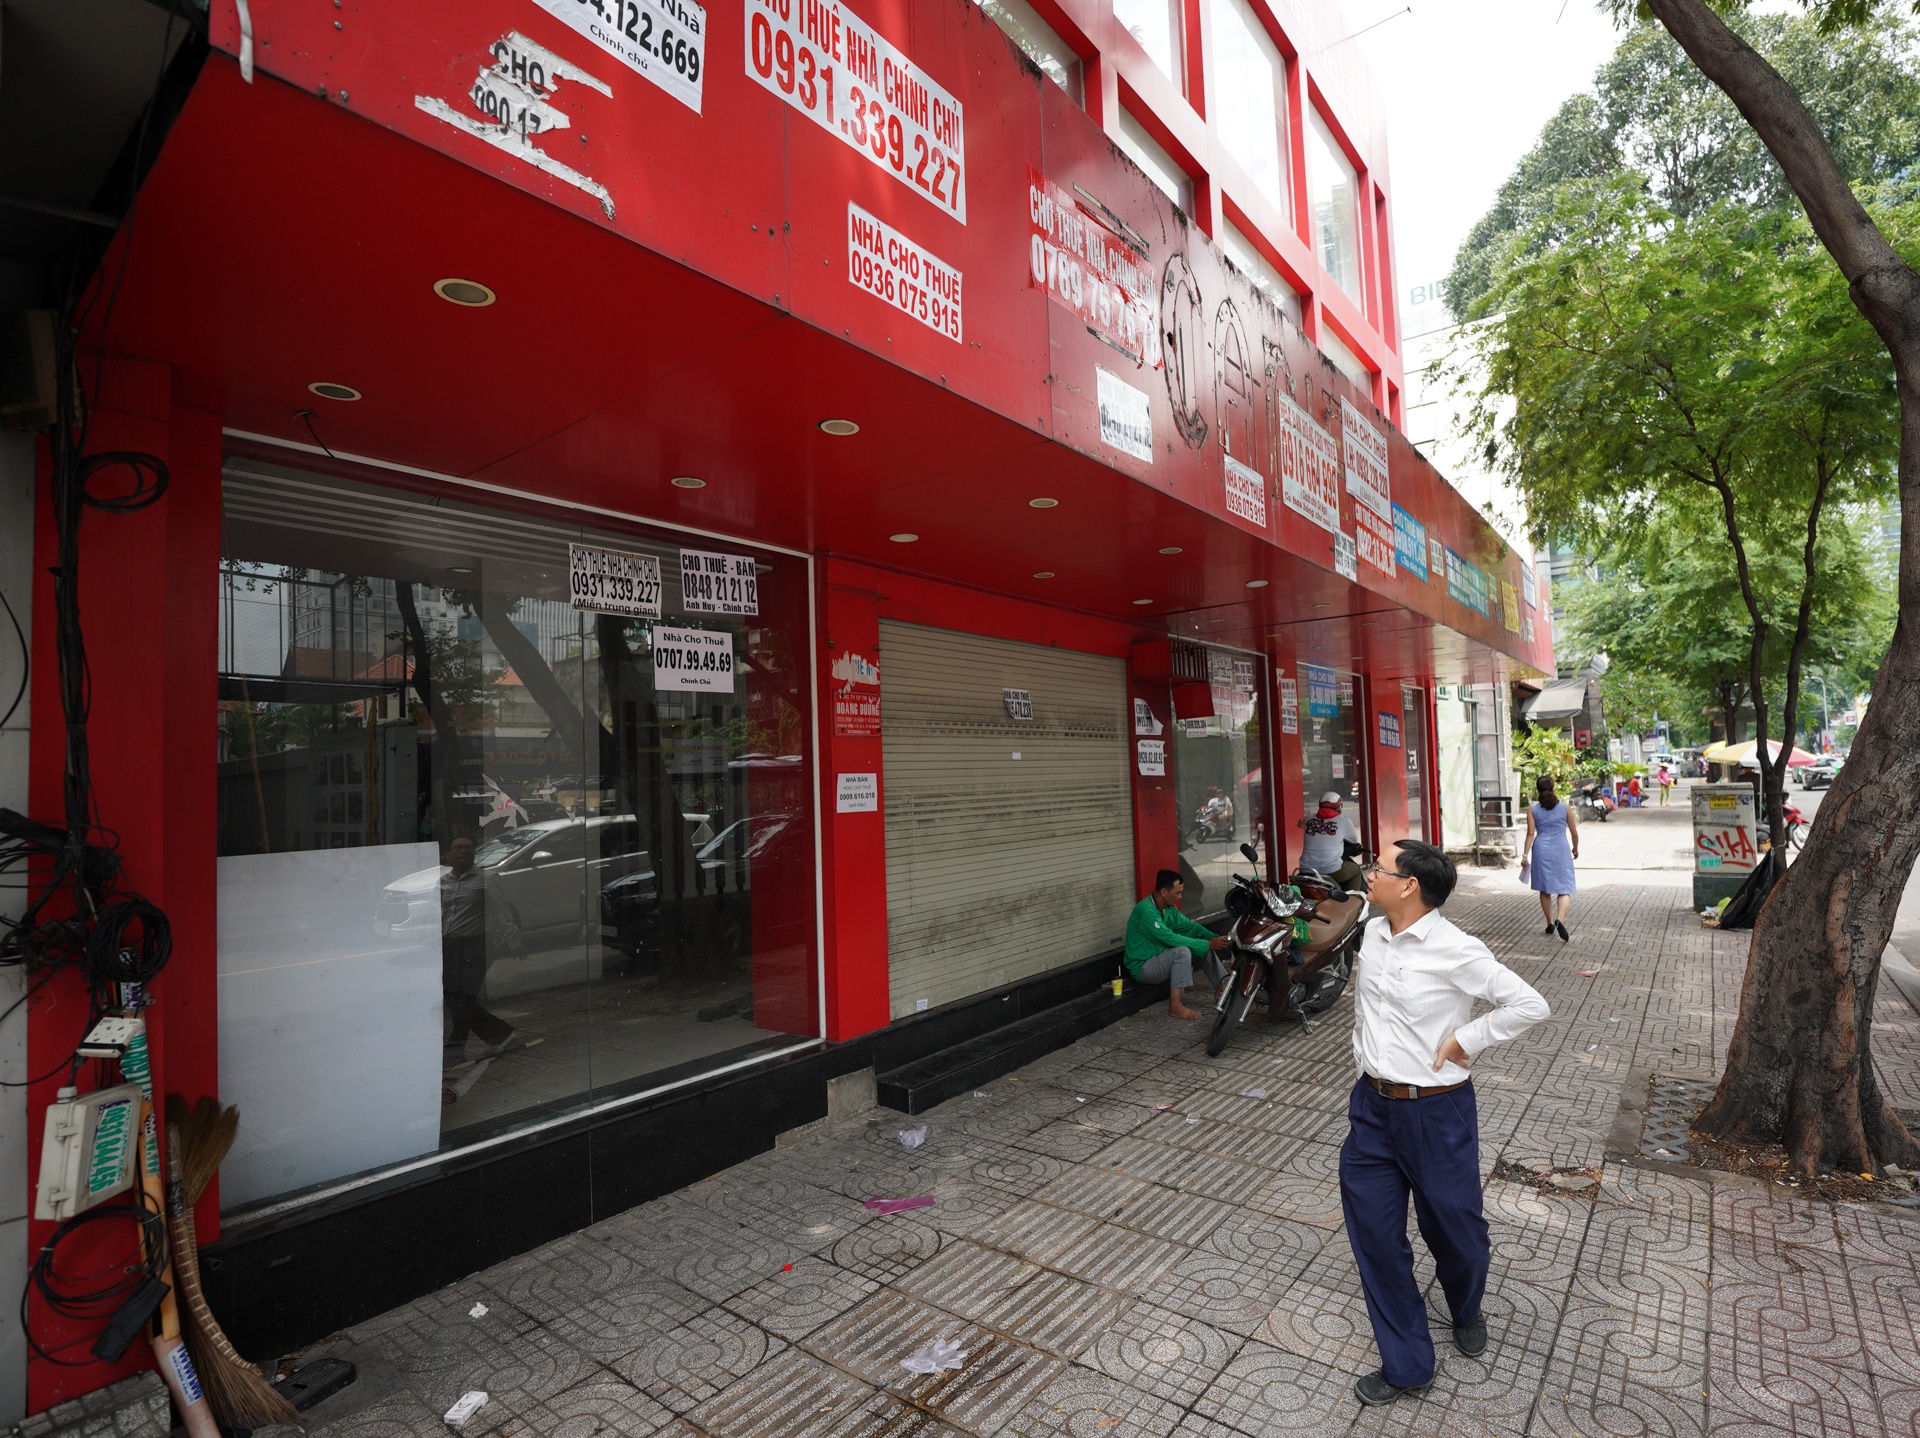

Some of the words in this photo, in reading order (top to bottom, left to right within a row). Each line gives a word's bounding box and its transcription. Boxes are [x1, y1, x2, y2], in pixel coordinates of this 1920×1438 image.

[590, 24, 624, 54] Chính
[627, 51, 648, 70] chủ
[493, 41, 545, 96] CHO
[846, 25, 880, 94] NHÀ
[883, 57, 929, 132] CHÍNH
[933, 98, 961, 156] CHỦ
[751, 11, 962, 212] 0931.339.227
[1029, 184, 1055, 236] CHO
[1055, 205, 1085, 259] THUÊ
[1085, 227, 1108, 275] NHÀ
[851, 212, 885, 261] NHÀ
[888, 237, 920, 281] CHO
[922, 259, 960, 307] THUÊ
[851, 249, 895, 302] 0936
[898, 277, 928, 321] 075
[931, 297, 959, 339] 915
[1031, 233, 1084, 309] 0789
[1086, 272, 1112, 328] 75
[1343, 407, 1359, 438] NHÀ
[1359, 423, 1373, 450] CHO
[1372, 436, 1387, 464] THUÊ
[1225, 468, 1238, 491] NHÀ
[1238, 475, 1250, 497] CHO
[1249, 481, 1264, 505] THUÊ
[572, 549, 587, 571] CHO
[588, 549, 606, 574] THUÊ
[607, 552, 622, 576] NHÀ
[623, 553, 643, 579] CHÍNH
[682, 553, 701, 572] CHO
[703, 555, 728, 574] THUÊ
[735, 558, 755, 578] BÁN
[572, 571, 660, 605] 0931.339.227
[683, 572, 713, 600] 0848
[715, 575, 728, 601] 21
[730, 577, 743, 602] 21
[744, 579, 757, 604] 12
[573, 598, 602, 610] (Miễn
[604, 601, 631, 615] trung
[633, 605, 657, 618] gian)
[686, 600, 701, 610] Anh
[702, 602, 716, 612] Huy
[722, 603, 742, 613] Chính
[663, 632, 682, 643] Nhà
[684, 634, 702, 644] Cho
[704, 636, 725, 646] Thuê
[656, 647, 731, 673] 0707.99.49.69
[836, 700, 859, 715] HOÀNG
[839, 791, 876, 801] 0909.616.018
